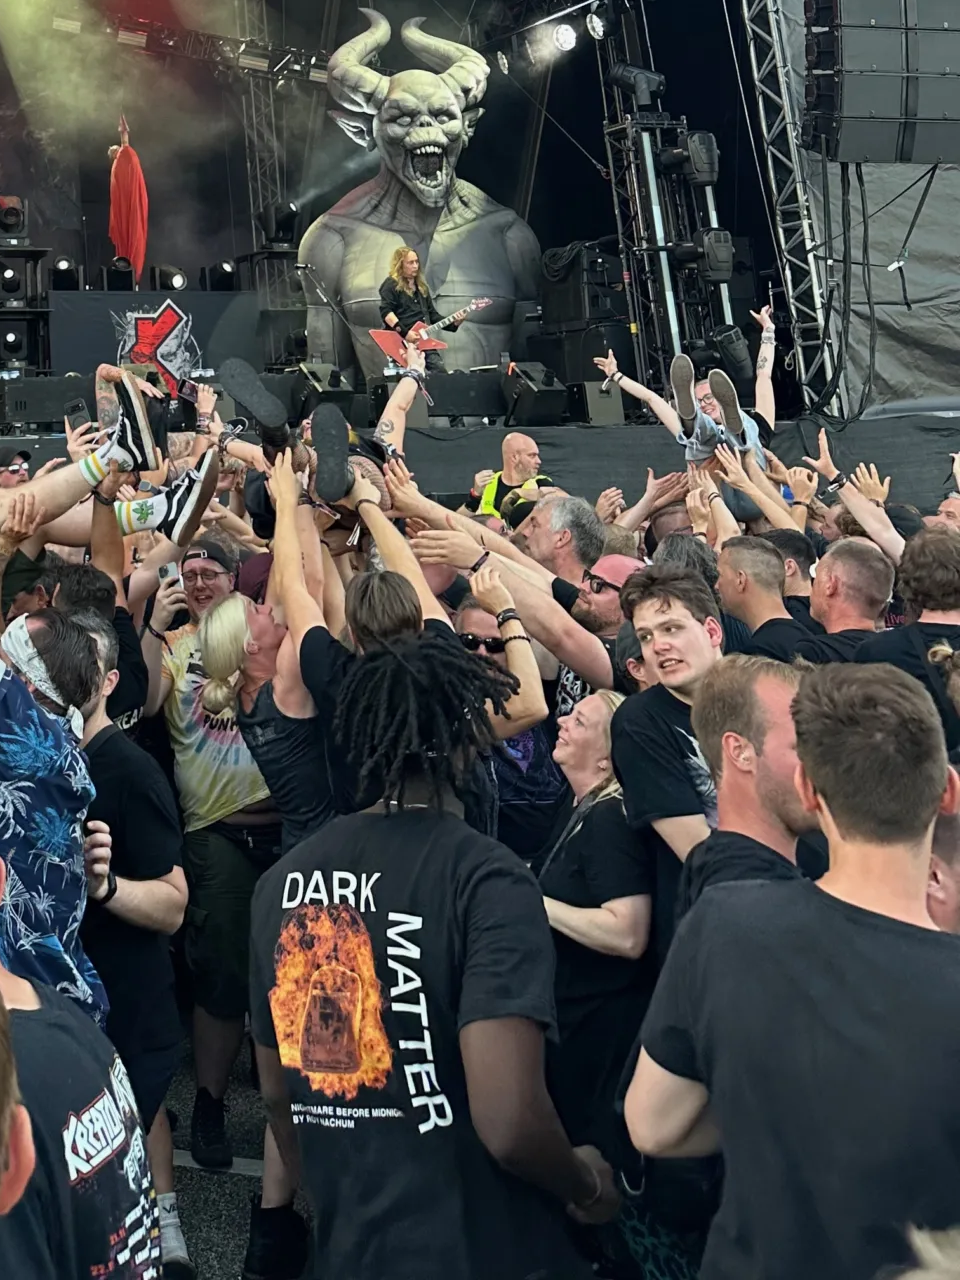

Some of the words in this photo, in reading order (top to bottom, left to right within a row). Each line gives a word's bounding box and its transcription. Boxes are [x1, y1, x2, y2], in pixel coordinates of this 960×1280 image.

[281, 870, 381, 912] DARK
[386, 912, 453, 1134] MATTER
[293, 1114, 305, 1124] BY
[336, 1107, 370, 1118] BEFORE
